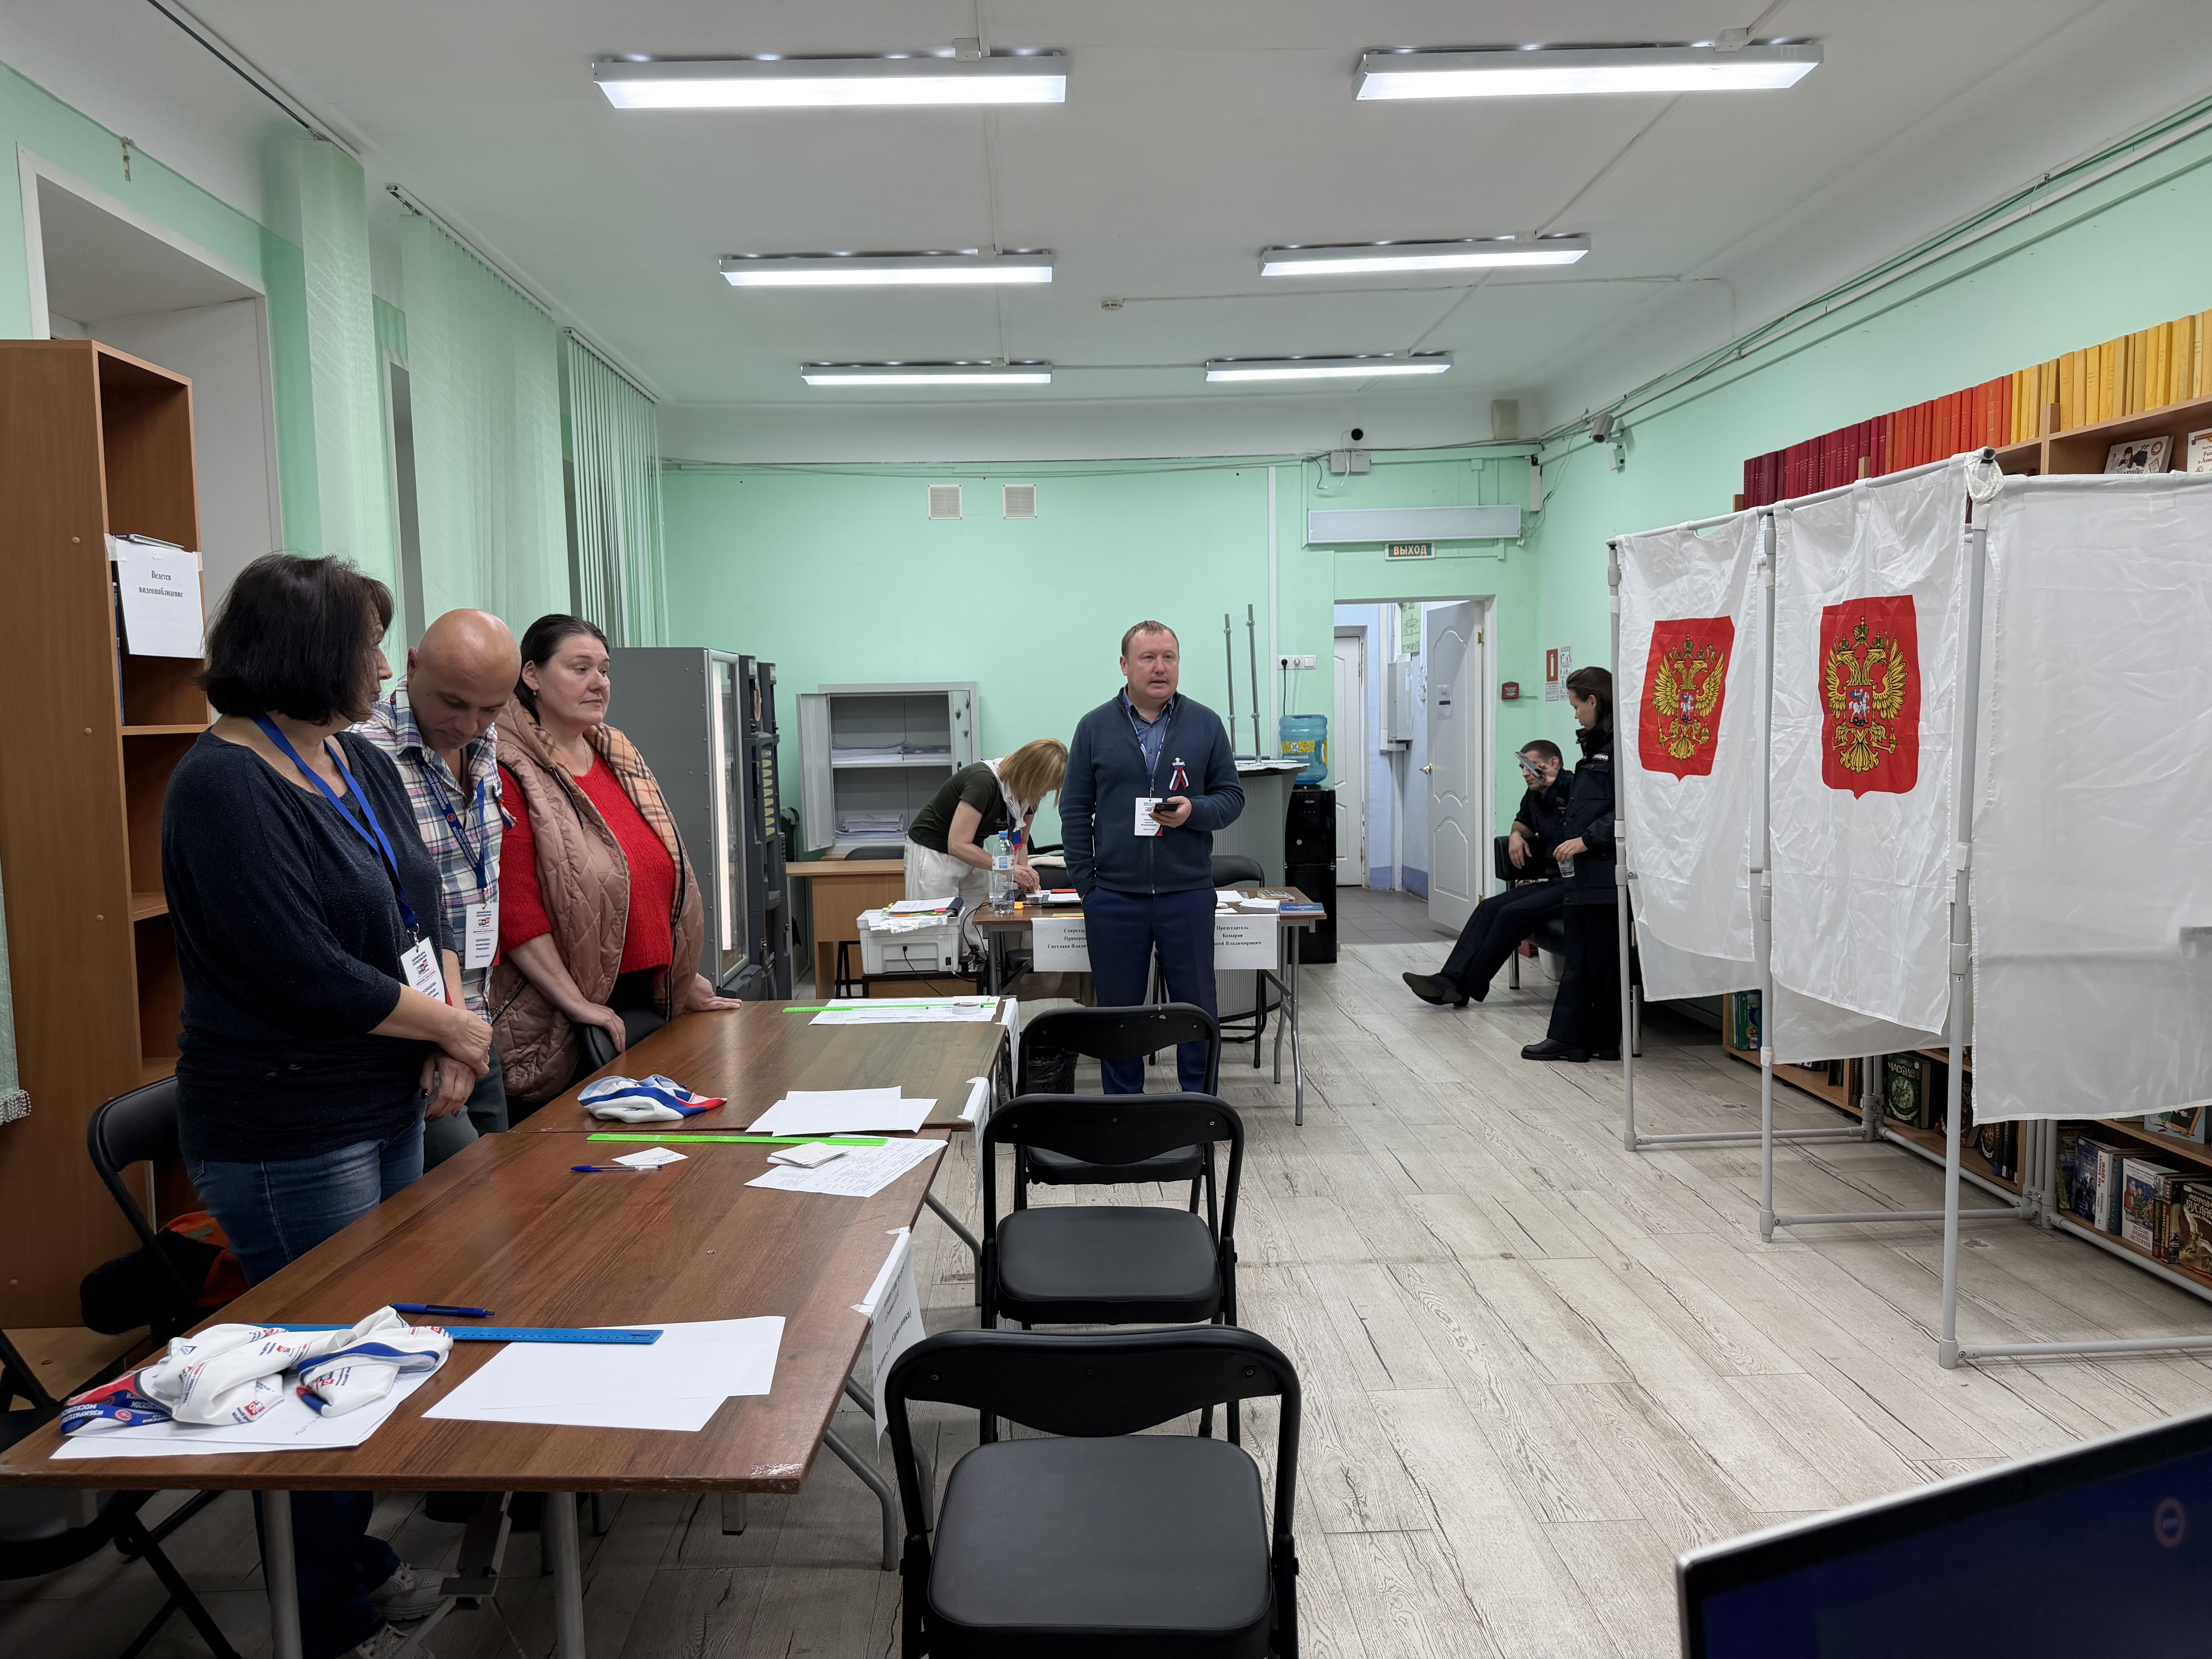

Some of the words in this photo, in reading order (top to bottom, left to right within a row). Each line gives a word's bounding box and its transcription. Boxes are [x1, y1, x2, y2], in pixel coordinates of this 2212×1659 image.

[1394, 545, 1427, 556] ВЫХОД
[151, 570, 171, 581] Ведется
[139, 587, 183, 598] видеонаблюдение
[2186, 1199, 2212, 1220] БУСЛАЕ
[2130, 1234, 2151, 1248] ИСТОРИИ
